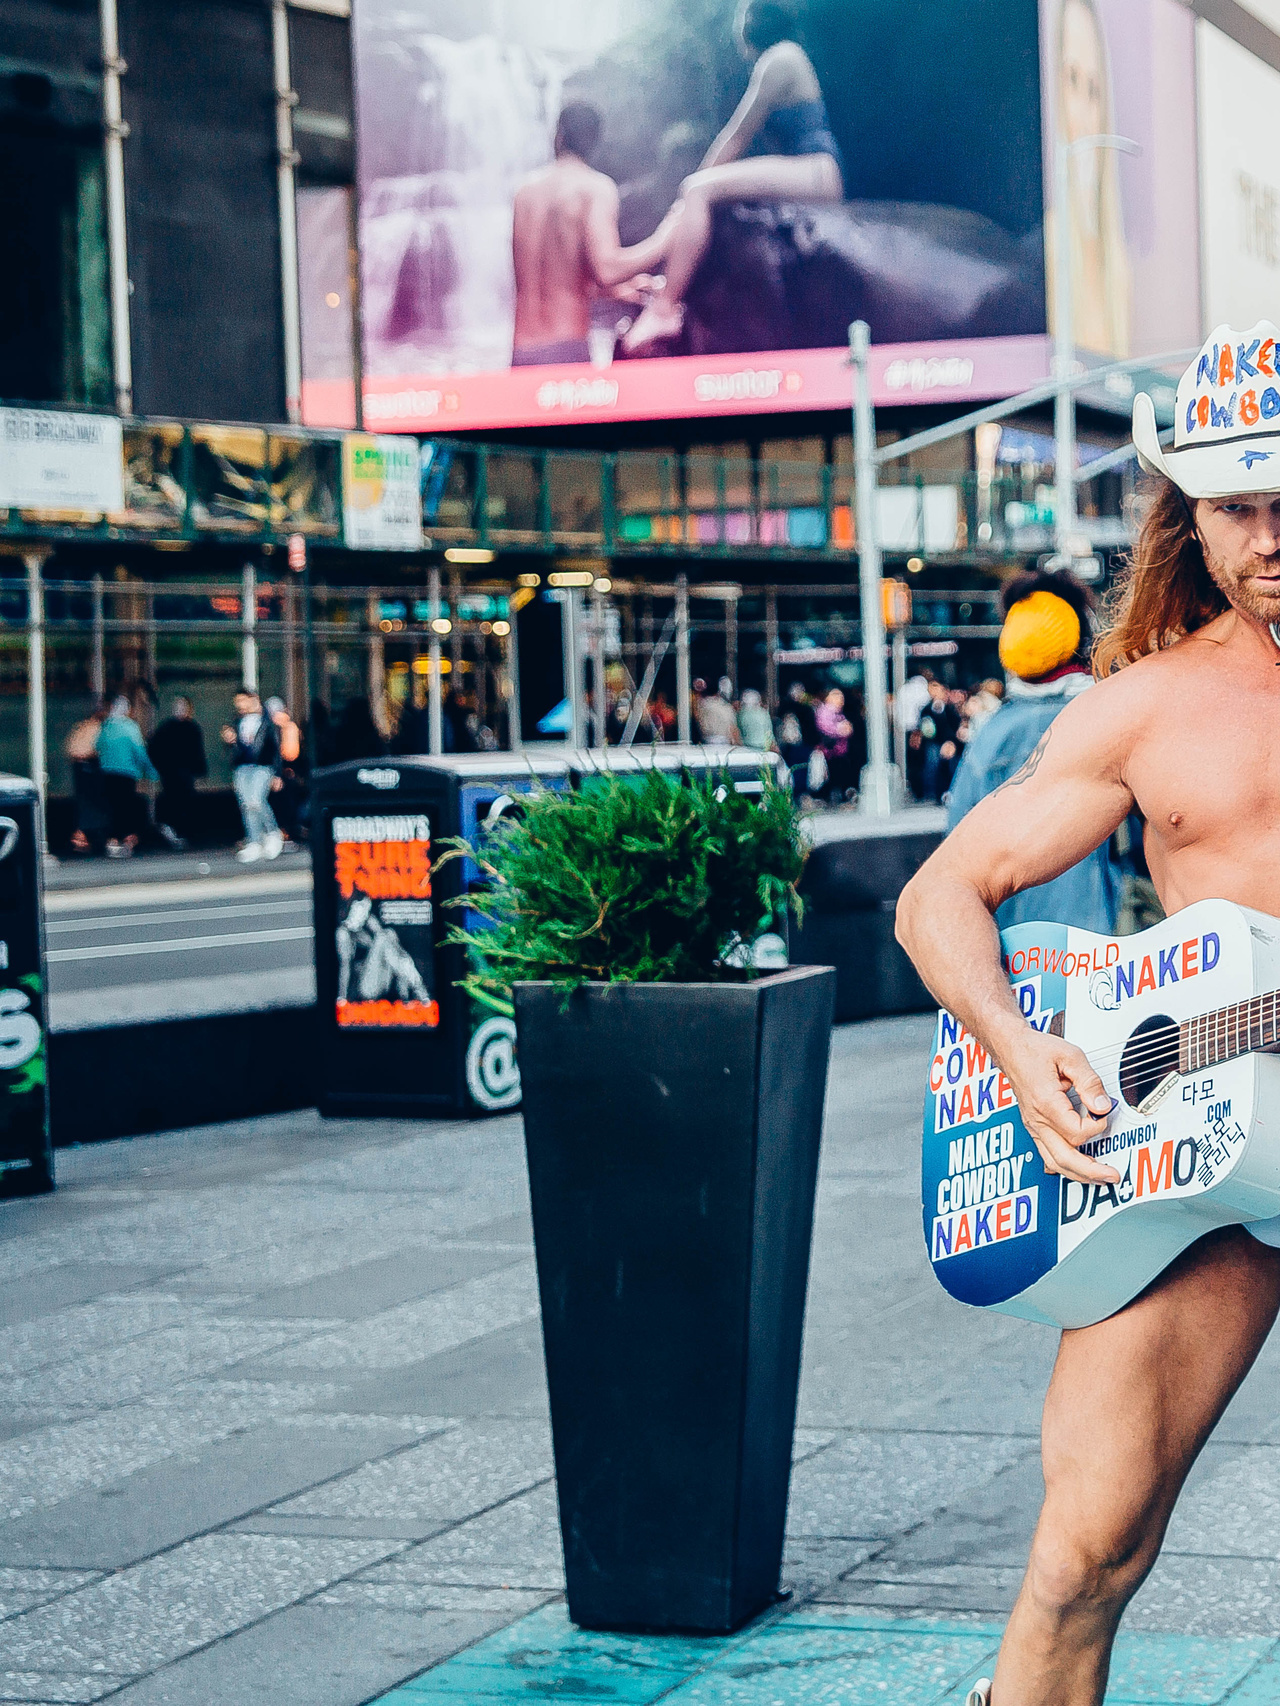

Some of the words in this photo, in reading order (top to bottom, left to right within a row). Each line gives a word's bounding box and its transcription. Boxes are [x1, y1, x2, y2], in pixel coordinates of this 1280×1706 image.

[1116, 932, 1220, 1002] NAKED
[939, 1072, 1013, 1129] NAKE
[1182, 1079, 1215, 1105] 다모
[948, 1121, 1014, 1177] NAKED
[936, 1194, 1032, 1258] NAKED
